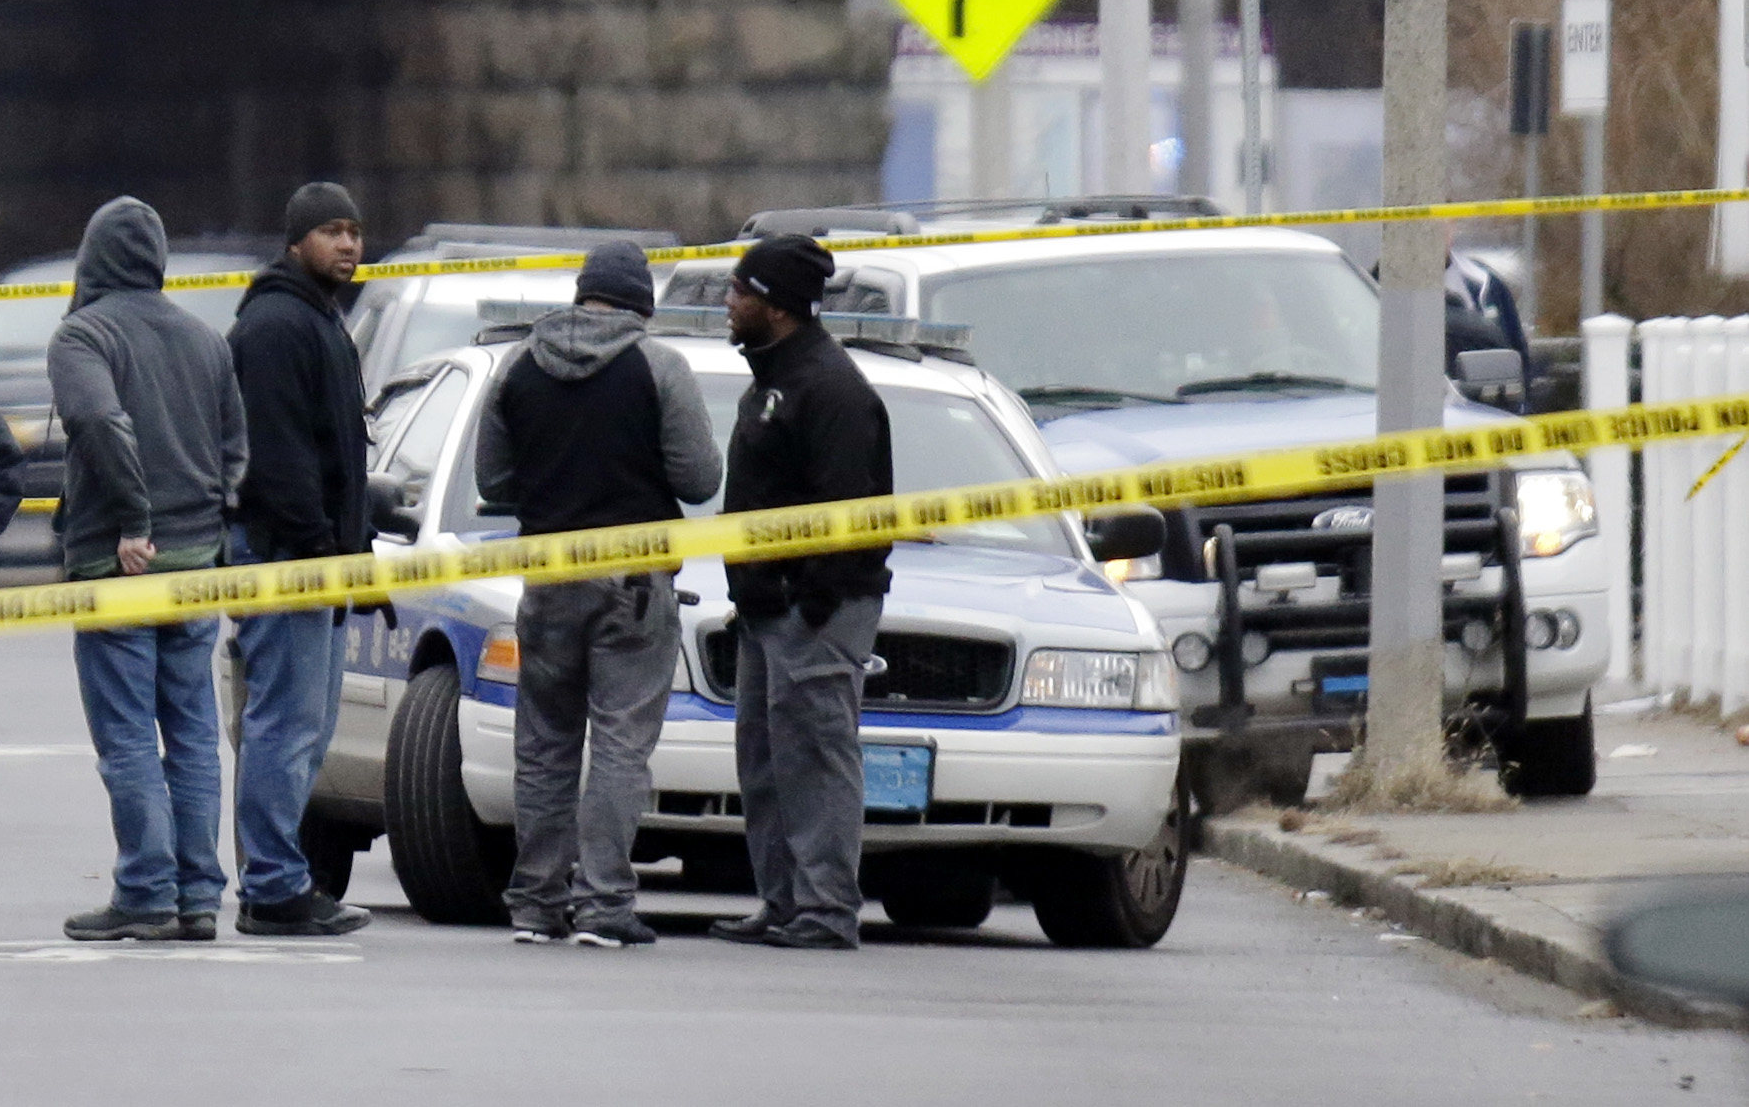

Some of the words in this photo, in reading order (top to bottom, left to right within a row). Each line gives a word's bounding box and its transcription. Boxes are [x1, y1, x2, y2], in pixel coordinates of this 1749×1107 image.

[1566, 21, 1605, 53] ENTER
[1032, 471, 1123, 511] POLICE
[1135, 459, 1244, 498] BOSTON
[912, 497, 948, 526] DO
[964, 487, 1017, 519] LINE
[1331, 509, 1372, 528] Ford
[744, 511, 831, 547] CROSS
[847, 505, 898, 535] NOT
[459, 541, 549, 577] POLICE
[563, 527, 670, 566] BOSTON
[273, 567, 325, 595] NOT
[340, 561, 376, 590] DO
[392, 553, 443, 585] LINE
[169, 571, 259, 605] CROSS
